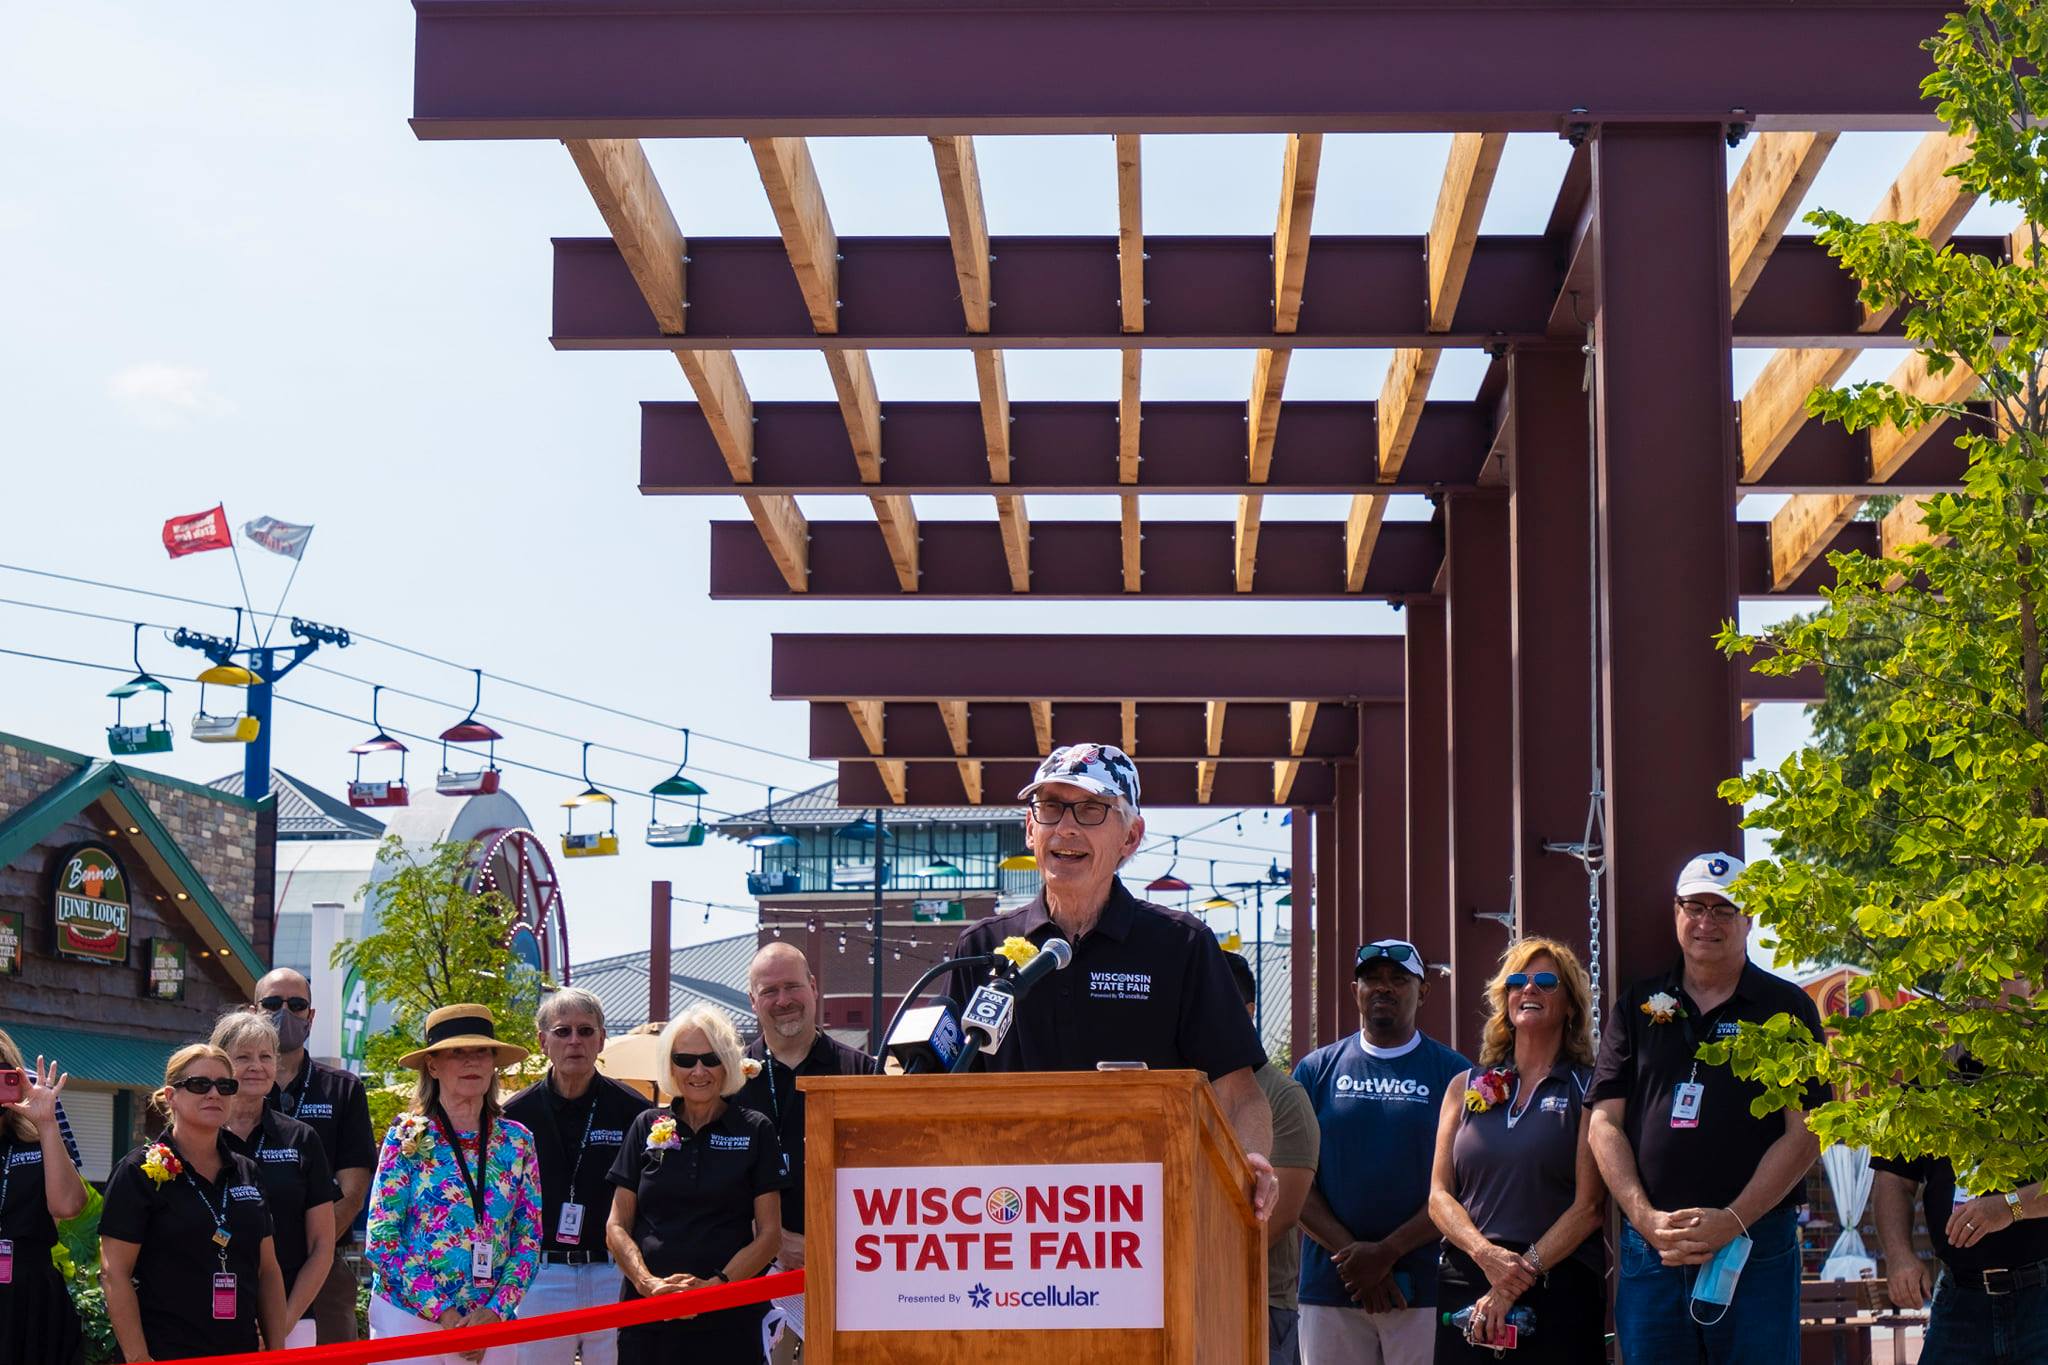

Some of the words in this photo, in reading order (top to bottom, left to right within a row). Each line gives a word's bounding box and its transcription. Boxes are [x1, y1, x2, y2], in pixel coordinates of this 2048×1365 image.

[251, 653, 263, 670] 5
[69, 859, 118, 889] Benno's
[58, 896, 91, 921] LEINIE
[93, 902, 126, 932] LODGE
[1090, 972, 1151, 984] WISCONSIN
[1090, 982, 1124, 991] STATE
[1127, 983, 1151, 993] FAIR
[982, 991, 1006, 1004] FOX
[977, 1002, 998, 1018] 6
[968, 1014, 995, 1026] NEWS
[1336, 1075, 1430, 1097] OutWiGo
[710, 1139, 732, 1147] STATE
[853, 1184, 1144, 1226] WISCONSIN
[855, 1232, 1014, 1272] STATE
[1030, 1231, 1144, 1270] FAIR
[898, 1294, 946, 1304] Presented
[948, 1293, 962, 1305] By
